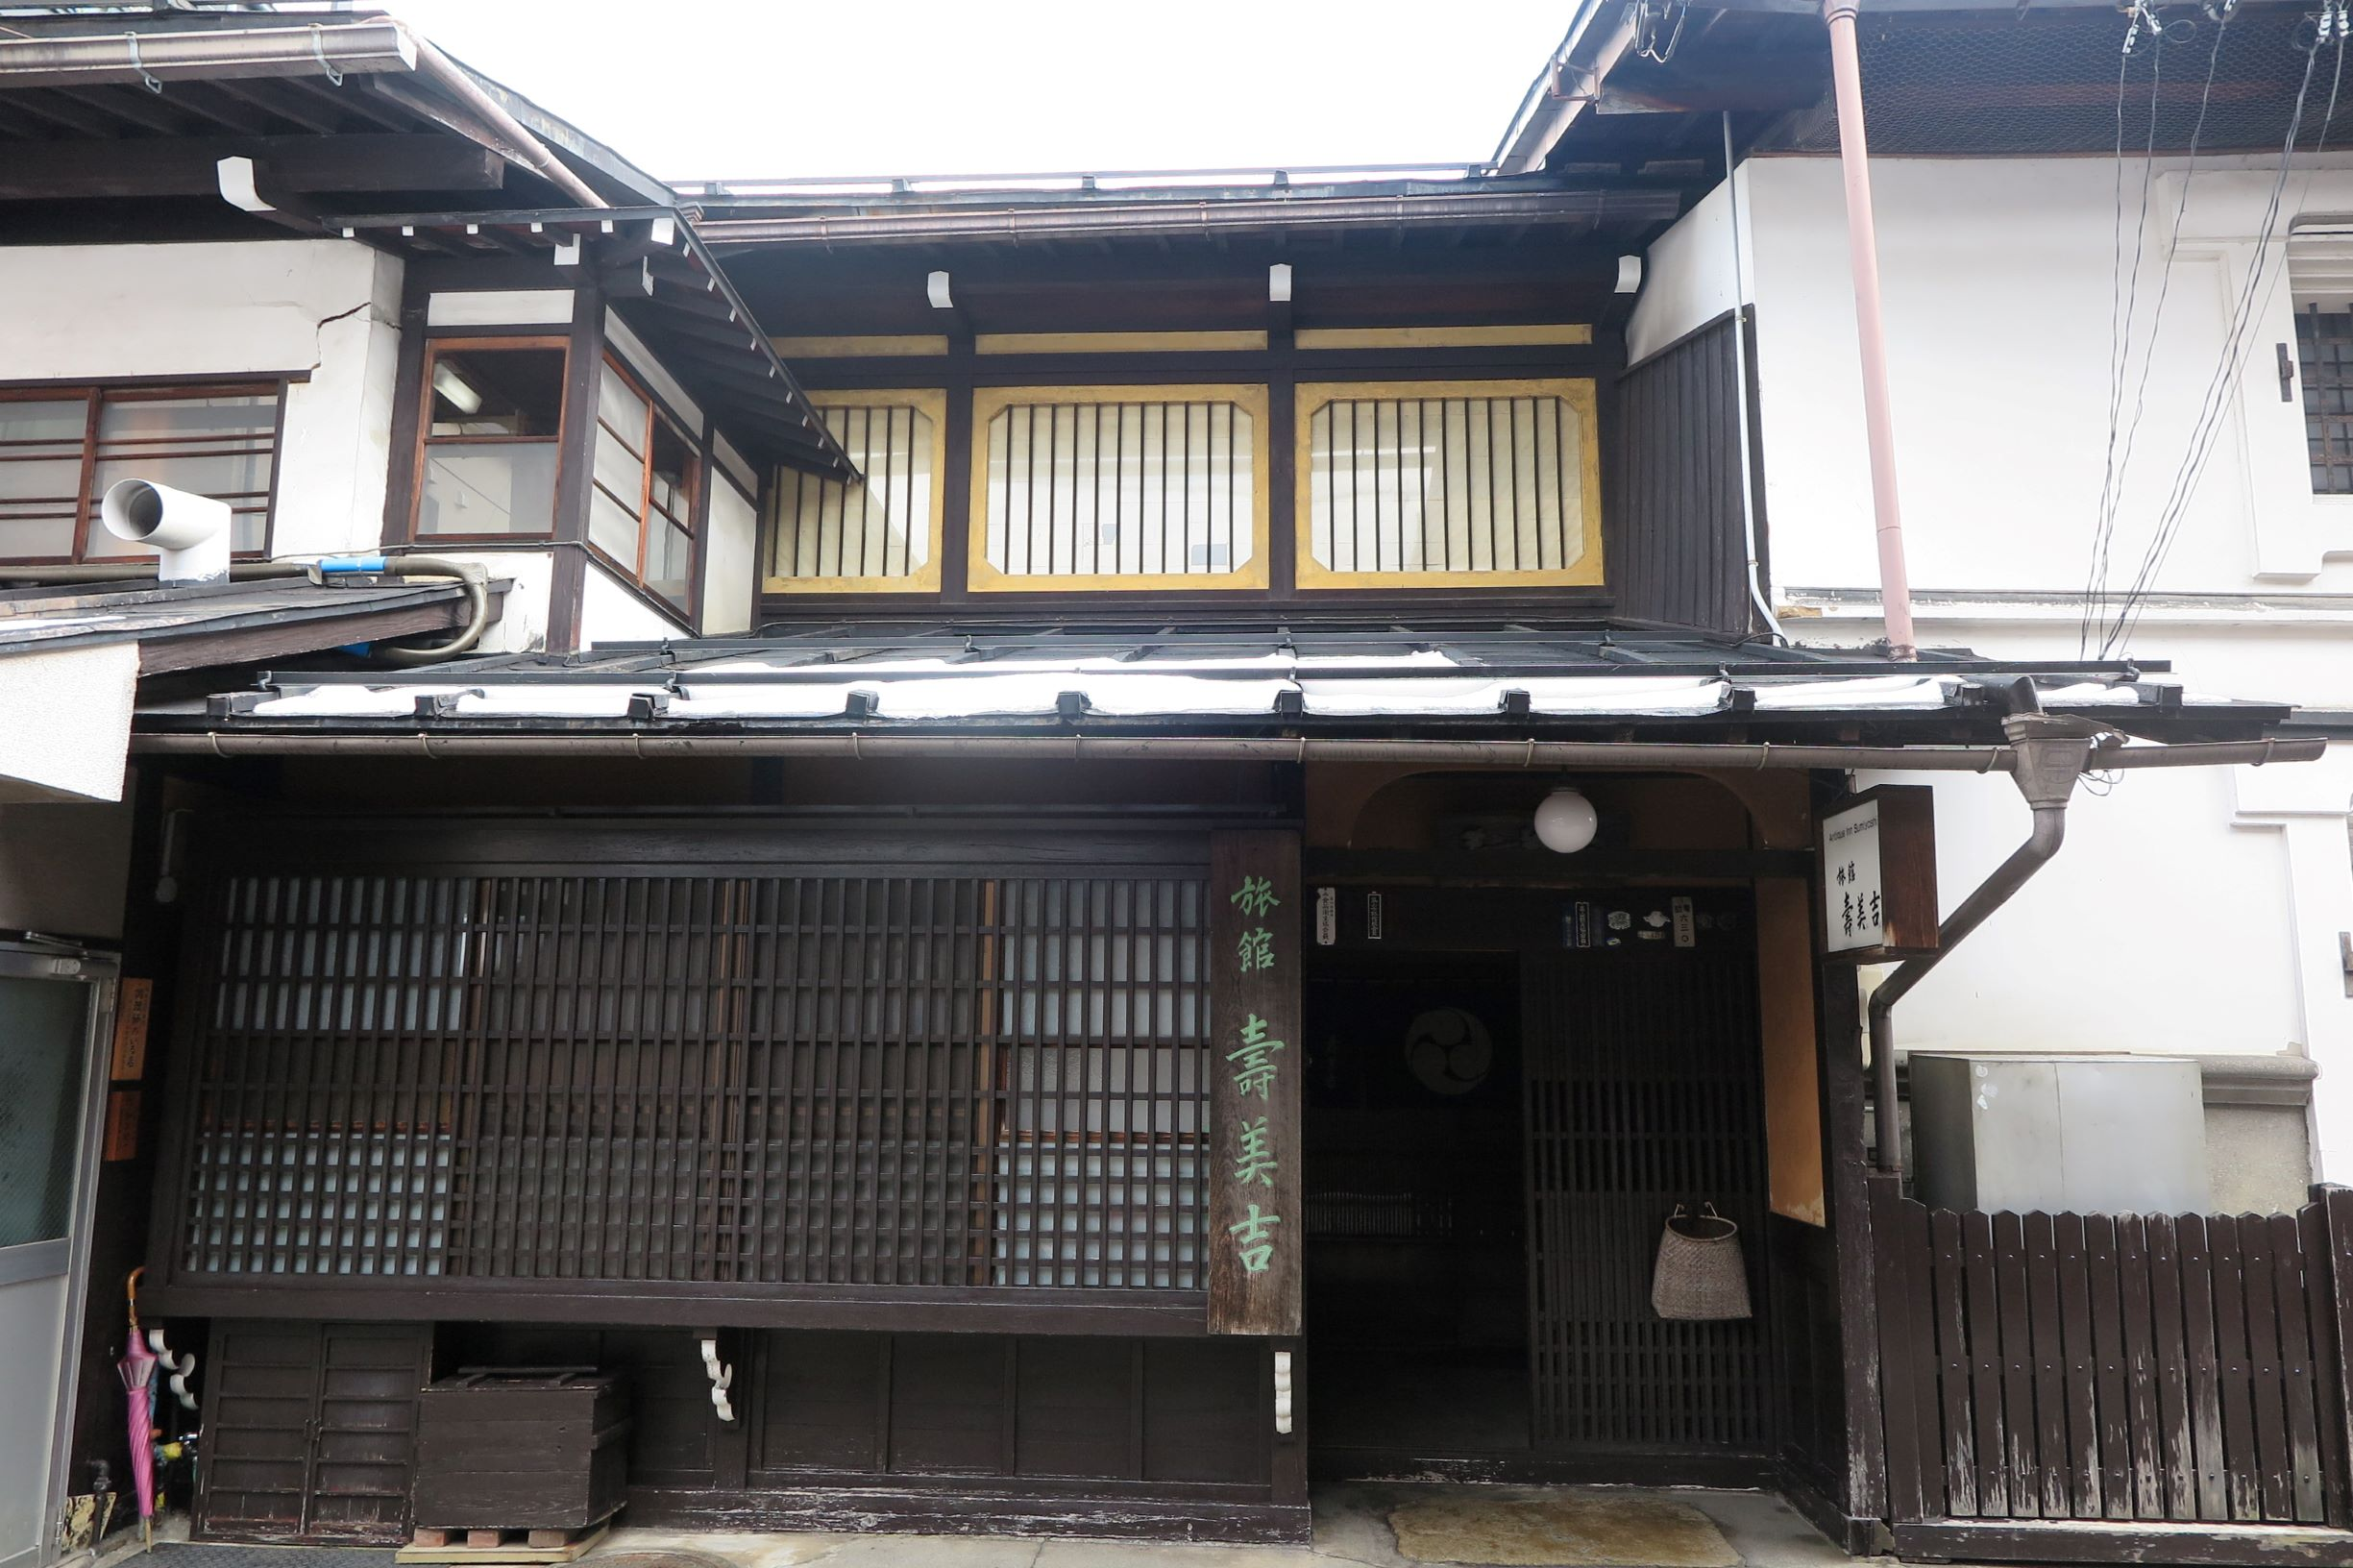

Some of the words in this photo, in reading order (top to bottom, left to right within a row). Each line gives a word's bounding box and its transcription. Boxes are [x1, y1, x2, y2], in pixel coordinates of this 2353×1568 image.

[1231, 875, 1281, 973] 旅館
[1224, 1013, 1287, 1274] 壽美吉
